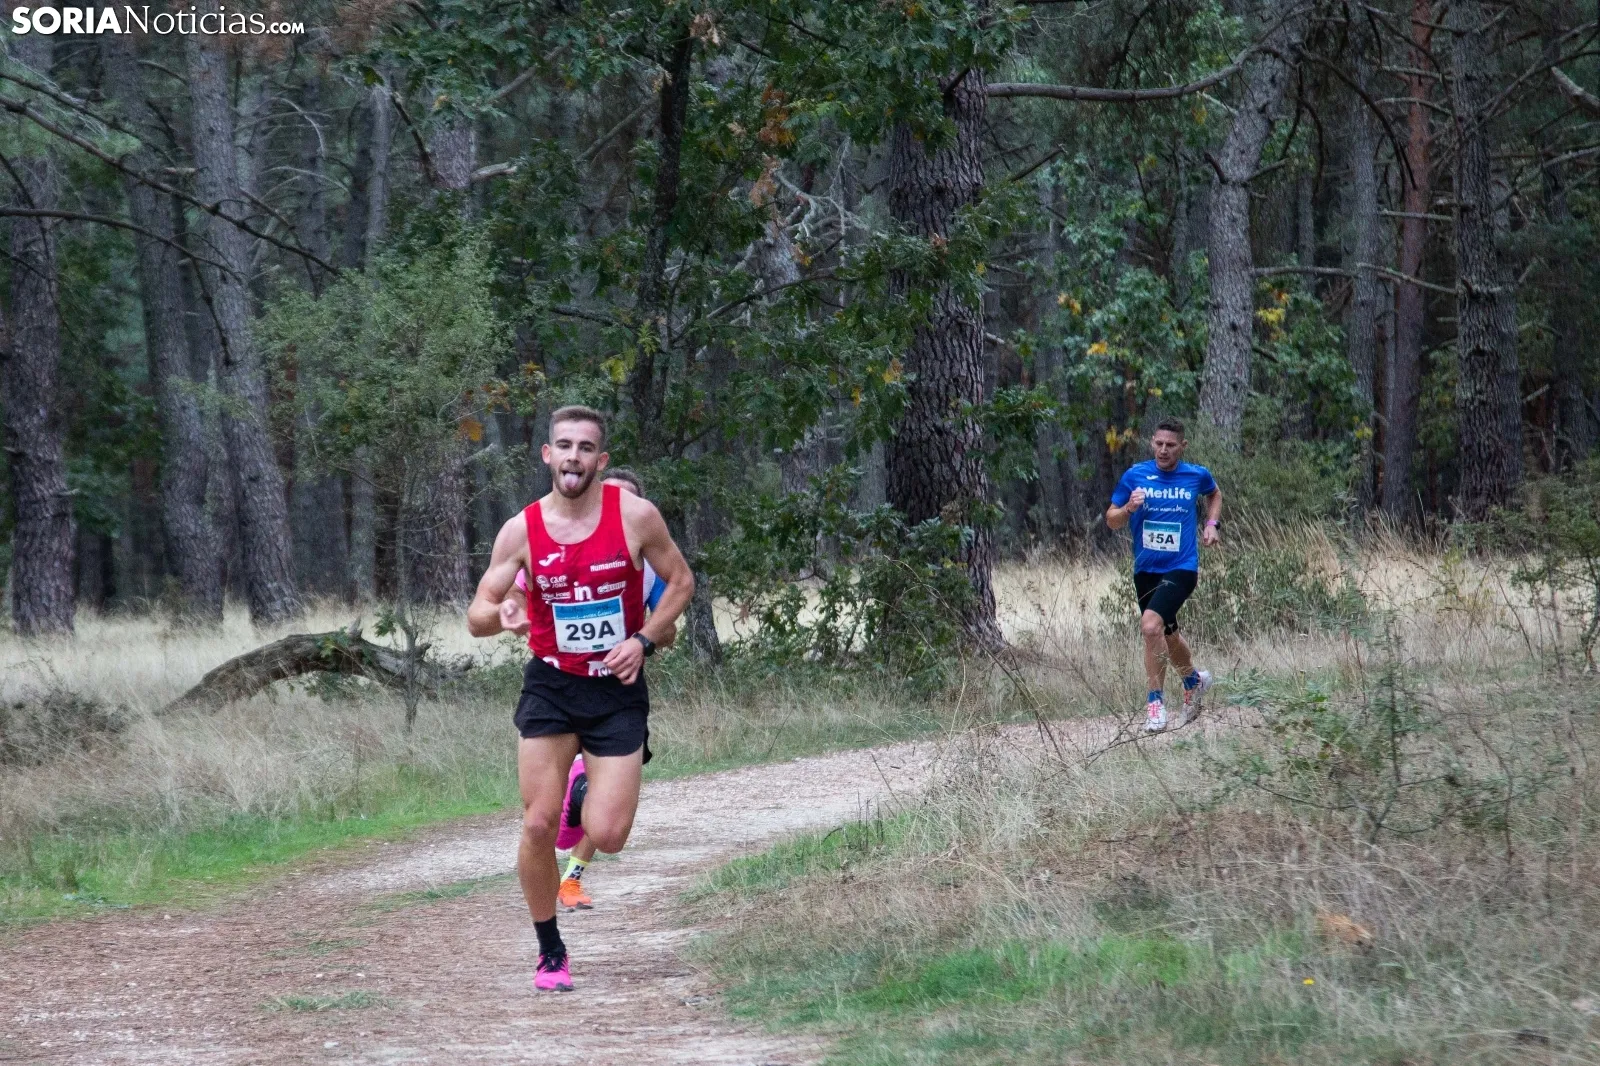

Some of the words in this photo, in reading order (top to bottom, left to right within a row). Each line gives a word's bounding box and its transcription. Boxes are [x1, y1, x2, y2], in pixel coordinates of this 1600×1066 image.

[1143, 487, 1192, 500] MetLife
[1148, 532, 1175, 544] 15A
[565, 620, 616, 642] 29A
